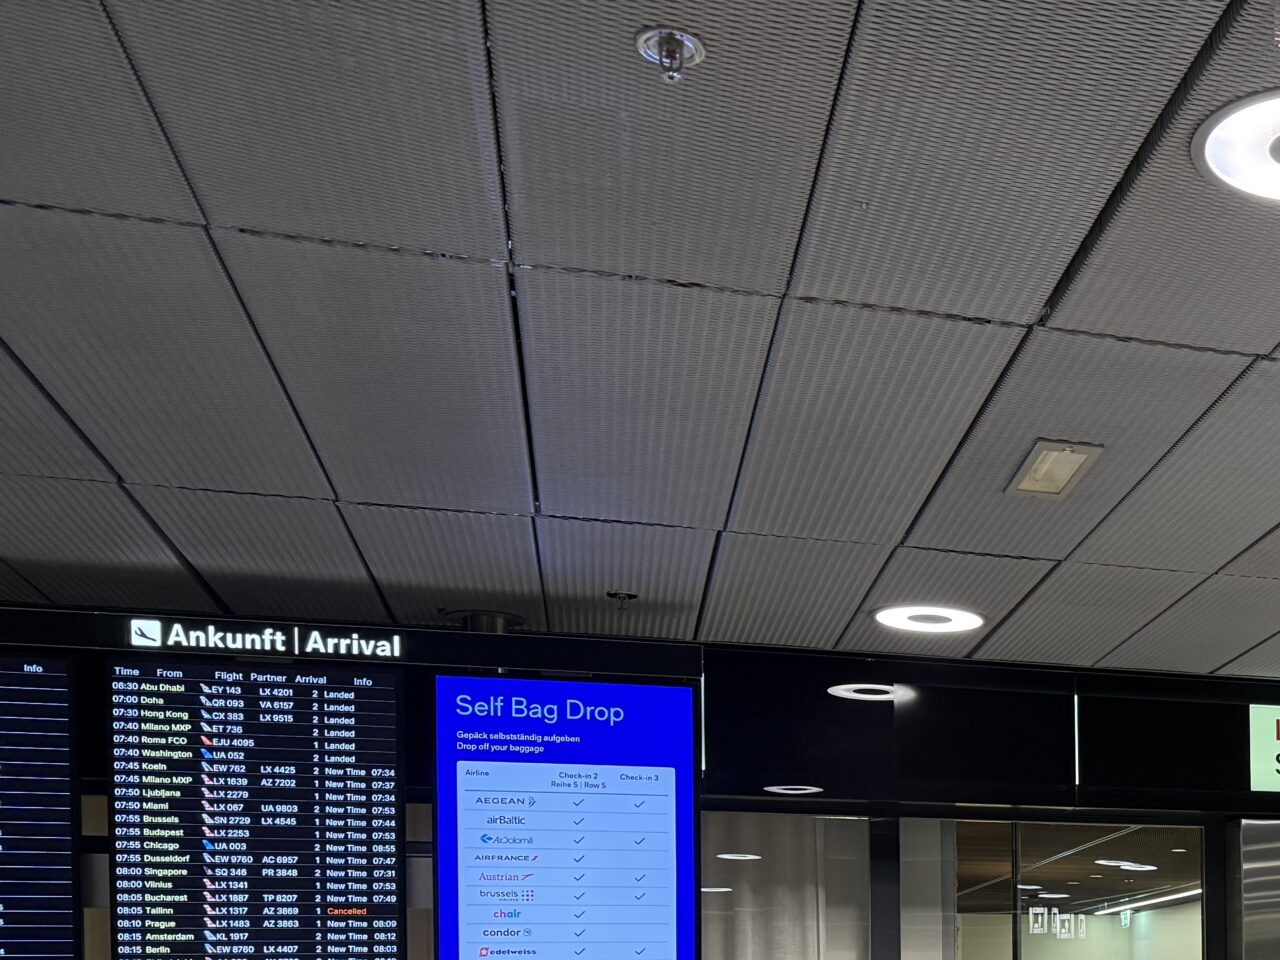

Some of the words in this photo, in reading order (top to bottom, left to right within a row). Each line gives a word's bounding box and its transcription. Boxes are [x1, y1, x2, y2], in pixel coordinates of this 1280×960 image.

[167, 624, 286, 651] Ankunft
[306, 631, 400, 656] Arrival
[23, 664, 43, 673] Info
[114, 667, 139, 676] Time
[157, 669, 183, 678] From
[215, 672, 243, 682] Flight
[251, 673, 287, 683] Partner
[295, 675, 326, 684] Arrival
[354, 677, 372, 686] Info
[112, 682, 138, 690] 06:30
[141, 683, 157, 691] Abu
[160, 684, 184, 692] Dhabi
[226, 686, 241, 694] 143
[260, 688, 270, 696] LX
[272, 688, 293, 696] 4201
[324, 691, 354, 699] Landed
[113, 696, 138, 704] 07:00
[141, 696, 164, 704] Doha
[456, 694, 504, 717] Self
[512, 697, 558, 724] Bag
[567, 699, 624, 725] Drop
[113, 709, 138, 717] 07:30
[141, 709, 164, 720] Hong
[166, 710, 188, 720] Kong
[113, 722, 139, 730] 07:40
[141, 722, 169, 731] Milano
[171, 723, 192, 732] MXP
[113, 735, 139, 743] 07:40
[142, 736, 165, 744] Roma
[168, 736, 187, 744] FCO
[457, 731, 487, 740] Gepäck
[490, 732, 541, 742] selbstständig
[544, 734, 580, 743] aufgeben
[457, 742, 477, 751] Drop
[491, 744, 508, 752] your
[510, 744, 544, 753] baggage
[114, 748, 139, 756] 07:40
[142, 749, 192, 759] Washington
[114, 761, 139, 770] 07:45
[142, 762, 167, 770] Koeln
[114, 775, 140, 783] 07:45
[142, 776, 170, 784] Milano
[172, 776, 192, 784] MXP
[114, 788, 140, 796] 07:50
[143, 789, 180, 798] Ljubljana
[115, 801, 140, 809] 07:50
[143, 802, 168, 810] Miami
[115, 814, 140, 823] 07:55
[143, 815, 179, 823] Brussels
[487, 815, 526, 824] airBaltic
[116, 828, 140, 836] 07:55
[144, 828, 184, 838] Budapest
[116, 841, 140, 849] 07:55
[144, 841, 179, 852] Chicago
[116, 854, 141, 862] 07:55
[144, 854, 190, 863] Dusseldorf
[231, 855, 253, 864] 9760
[277, 856, 298, 864] 6957
[116, 867, 142, 875] 08:00
[144, 868, 187, 878] Singapore
[479, 873, 519, 881] Austrian
[116, 880, 142, 888] 08:00
[145, 880, 173, 888] Vilnius
[117, 893, 142, 901] 08:05
[145, 893, 187, 902] Bucharest
[117, 907, 143, 915] 08:05
[146, 906, 173, 915] Tallinn
[229, 906, 248, 914] 1317
[277, 907, 298, 915] 3869
[493, 910, 521, 918] chair
[117, 920, 142, 928] 08:10
[146, 919, 176, 930] Prague
[118, 933, 142, 941] 08:15
[146, 932, 194, 941] Amsterdam
[146, 946, 170, 954] Berlin
